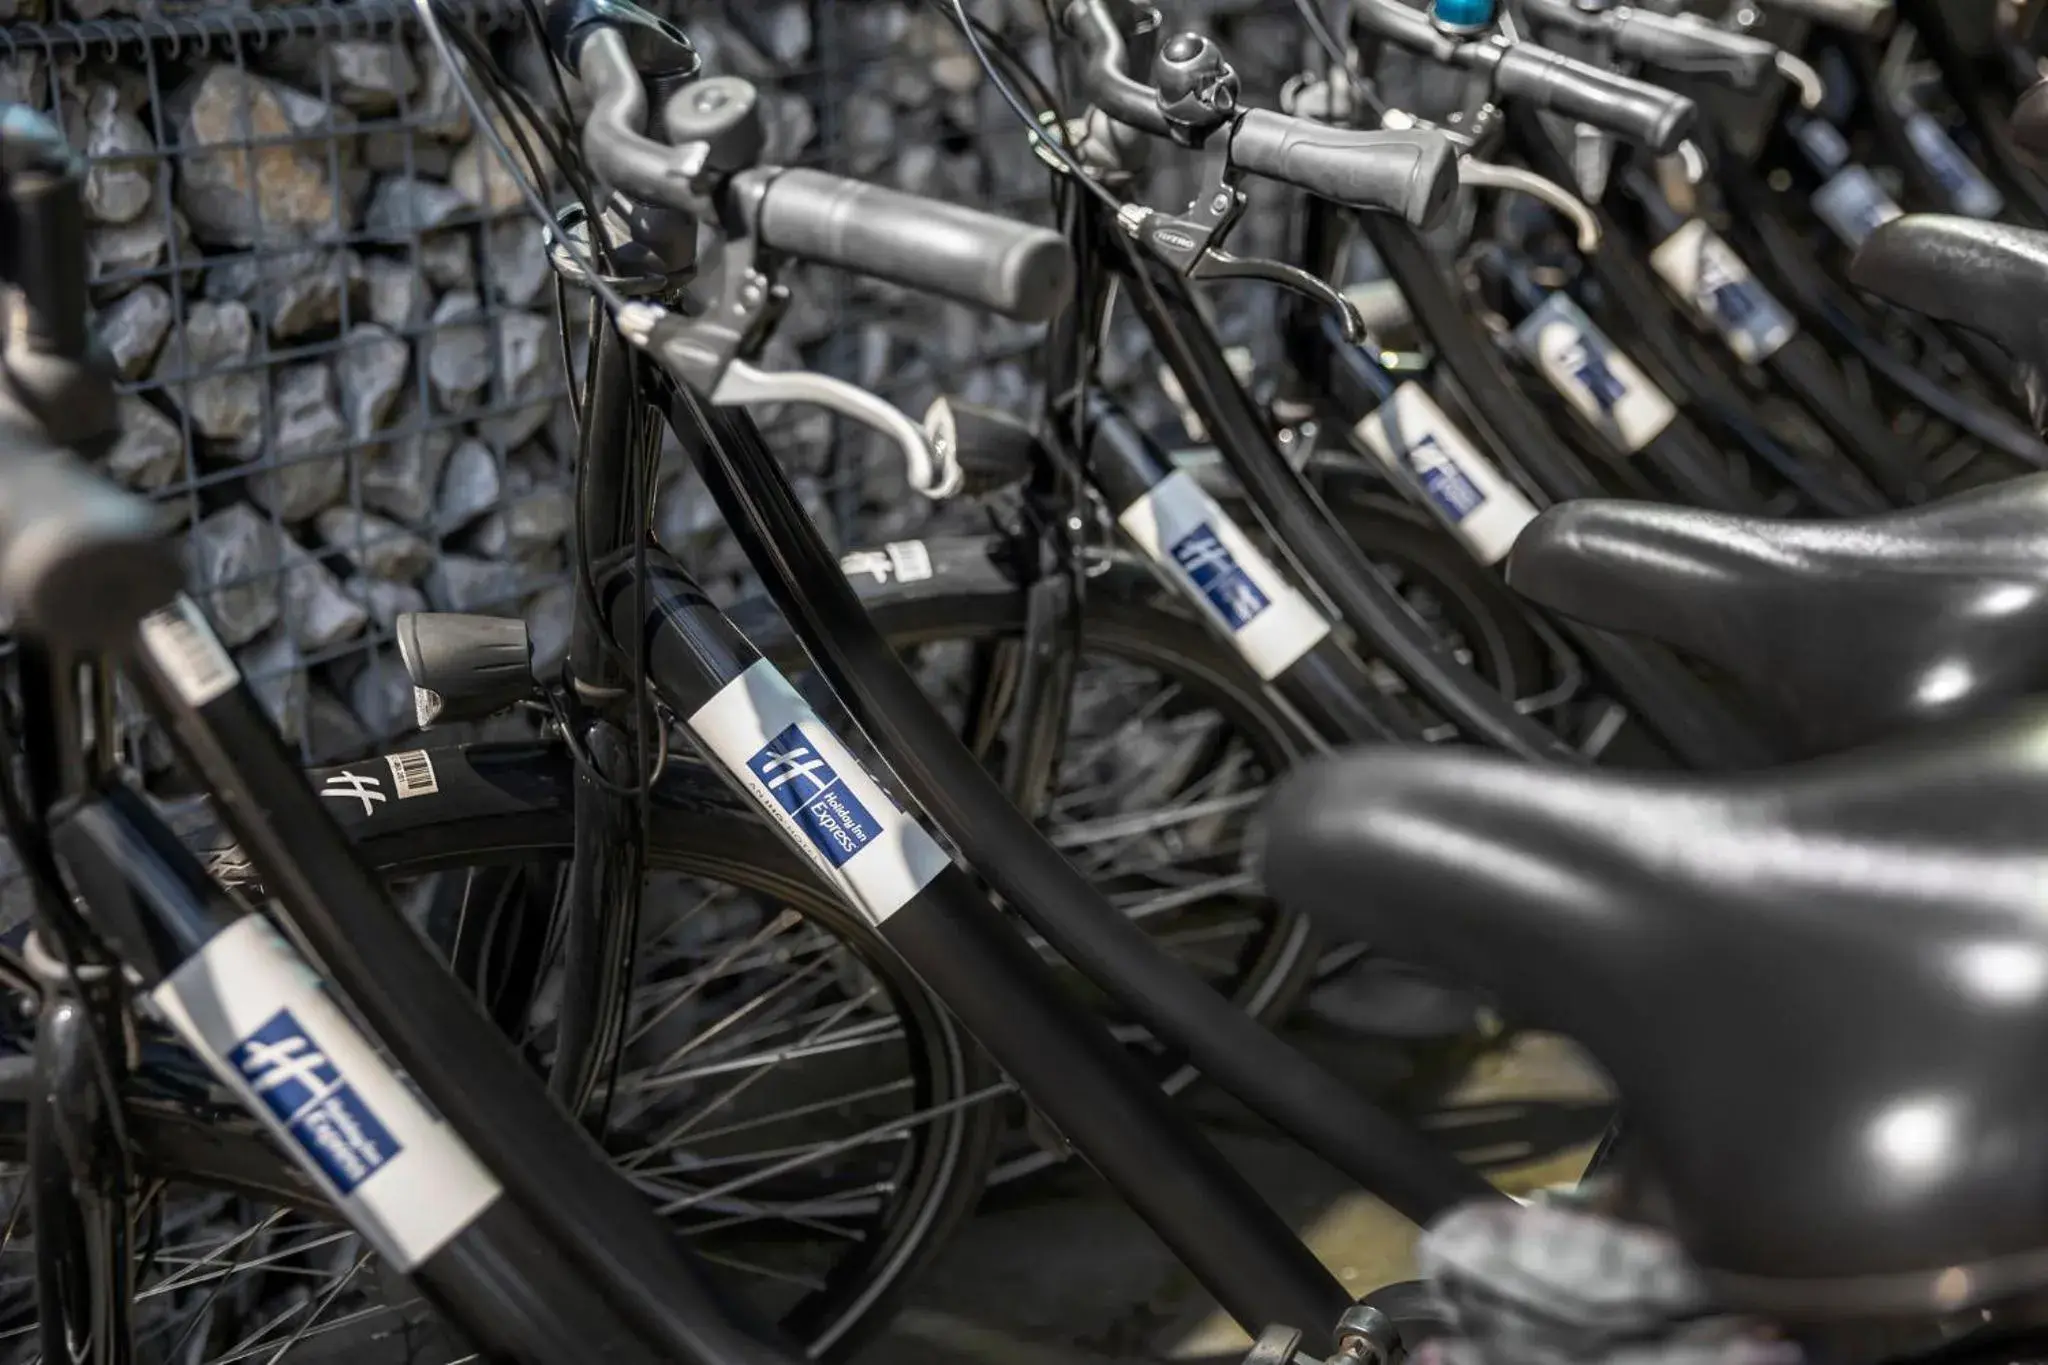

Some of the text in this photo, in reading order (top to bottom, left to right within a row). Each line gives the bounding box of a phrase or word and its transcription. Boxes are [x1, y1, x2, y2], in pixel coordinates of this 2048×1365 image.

[810, 802, 858, 853] Express
[824, 791, 868, 843] Holiday Inn
